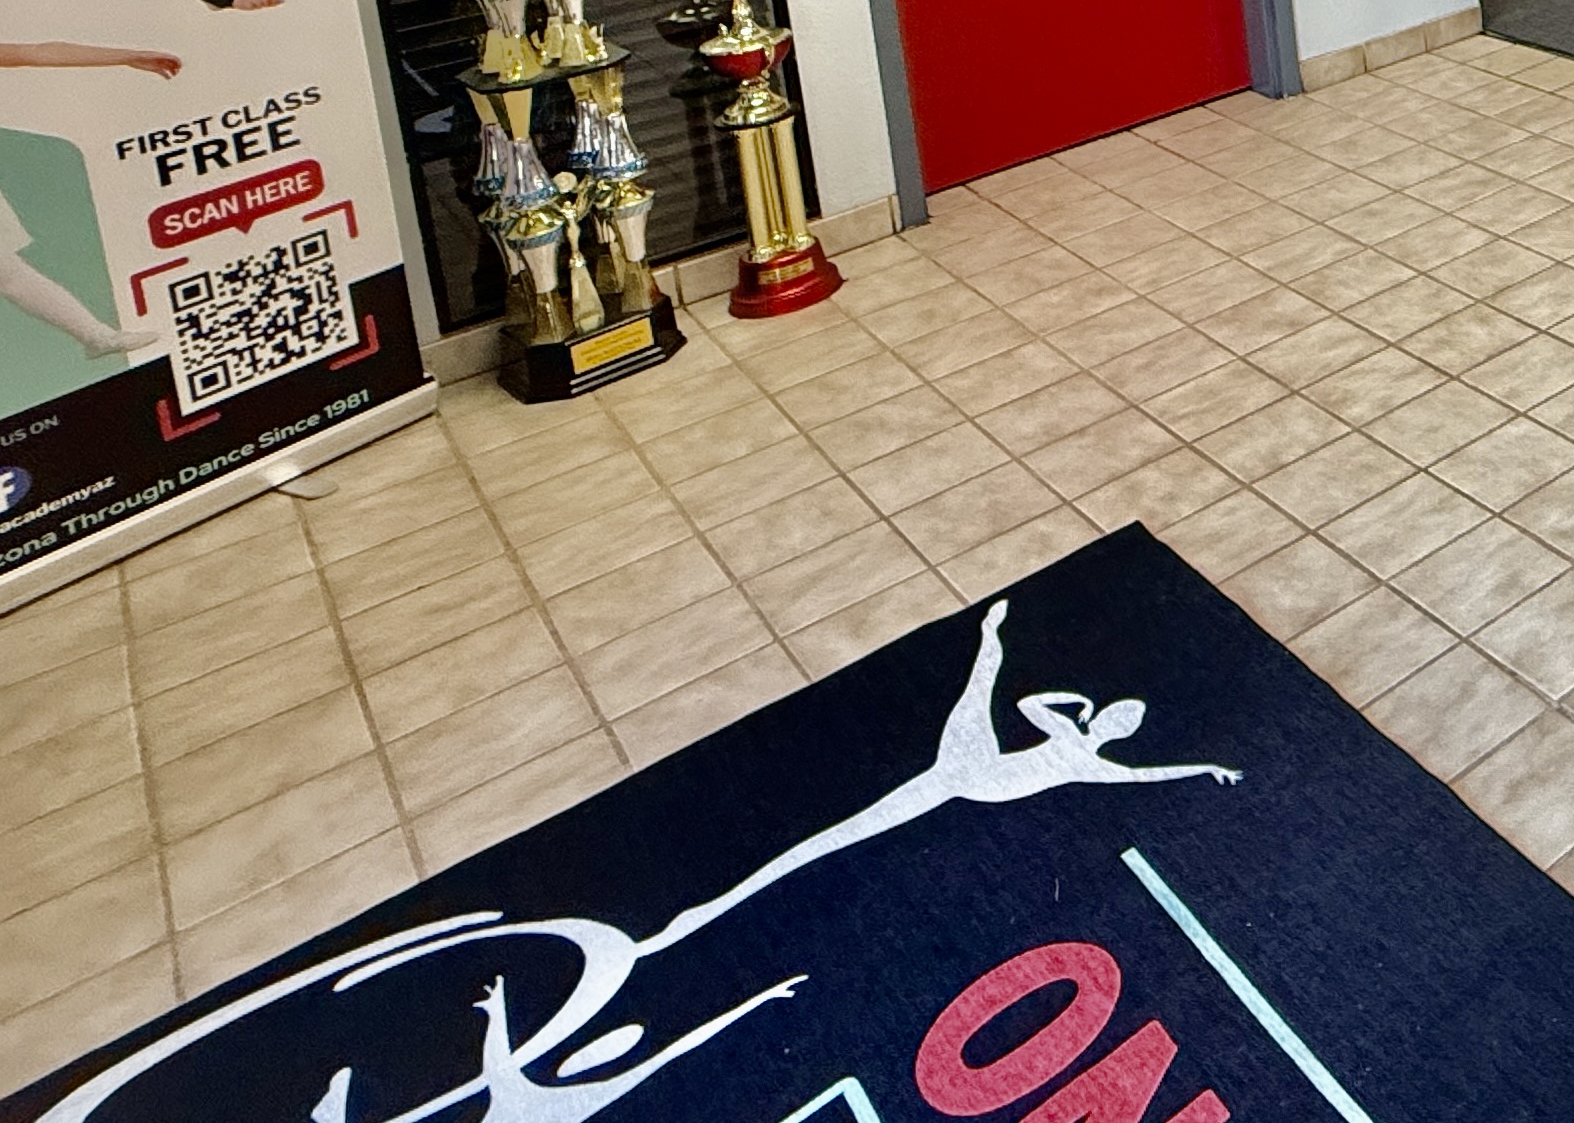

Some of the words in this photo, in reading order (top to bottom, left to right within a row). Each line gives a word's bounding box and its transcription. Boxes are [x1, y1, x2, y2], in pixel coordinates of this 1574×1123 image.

[114, 116, 213, 161] FIRST
[221, 86, 322, 131] CLASS
[153, 115, 301, 188] FREE
[162, 195, 241, 236] SCAN
[245, 170, 312, 209] HERE
[0, 428, 27, 447] US
[30, 415, 60, 435] ON
[61, 478, 175, 535] Through
[179, 443, 255, 486] Dance
[259, 412, 321, 449] Since
[323, 388, 371, 419] 1981
